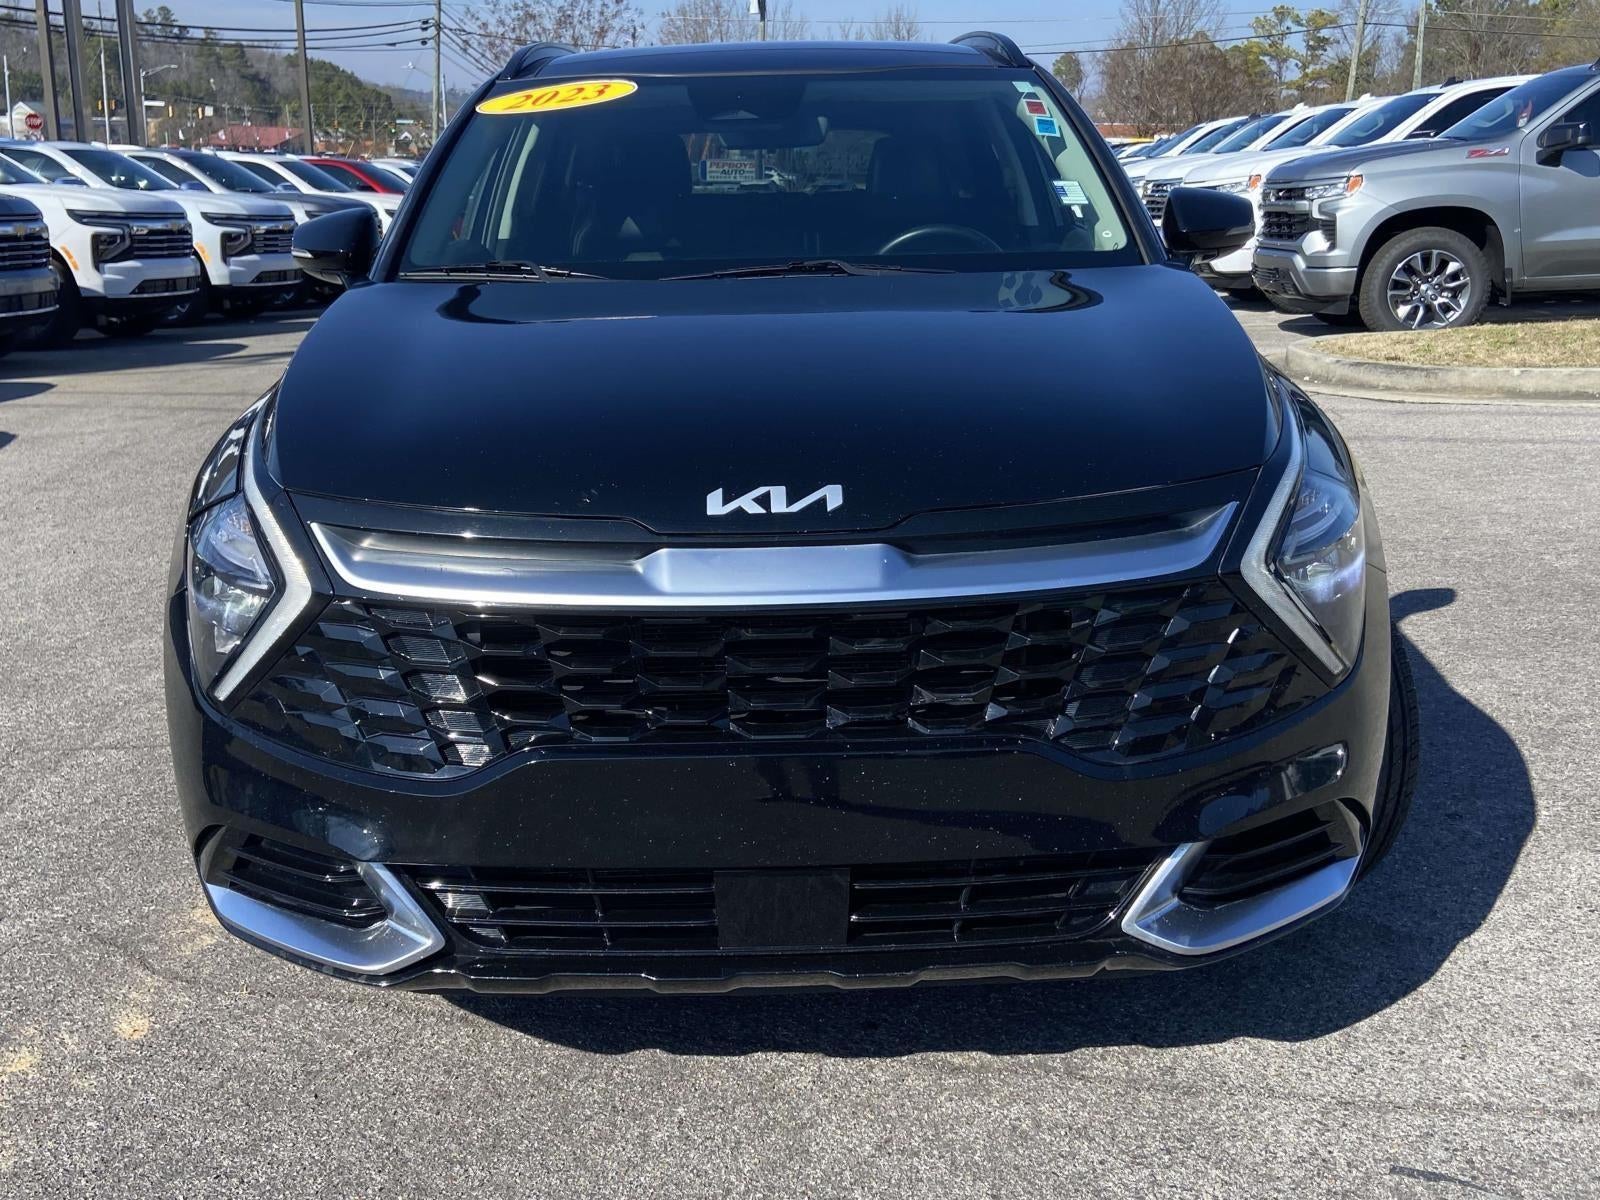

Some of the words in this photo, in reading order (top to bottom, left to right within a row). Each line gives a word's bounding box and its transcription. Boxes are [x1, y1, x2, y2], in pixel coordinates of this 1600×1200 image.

[503, 84, 611, 110] 2023
[26, 117, 42, 127] STOP
[707, 484, 843, 515] KIA
